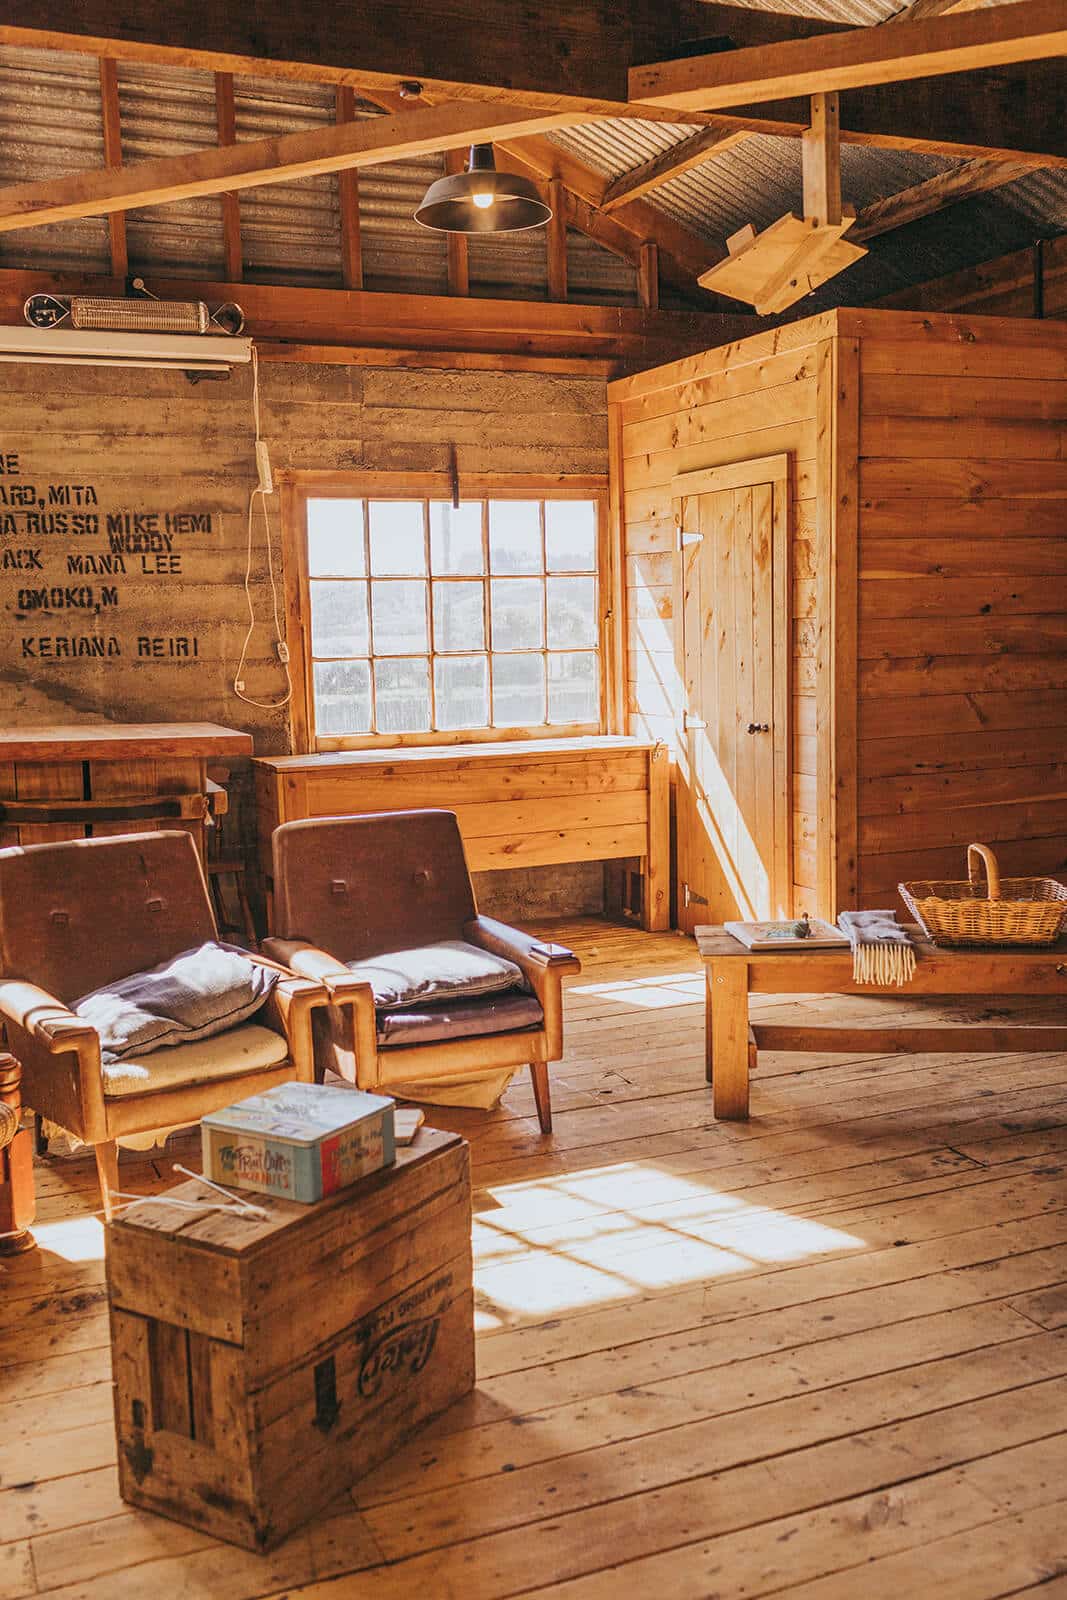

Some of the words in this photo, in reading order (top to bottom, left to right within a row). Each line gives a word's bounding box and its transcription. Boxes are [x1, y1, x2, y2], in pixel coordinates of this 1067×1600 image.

[106, 512, 159, 534] MIKE
[67, 555, 126, 574] MANA
[141, 555, 183, 575] LEE
[21, 636, 121, 657] KERIANA
[137, 636, 199, 657] REIRI
